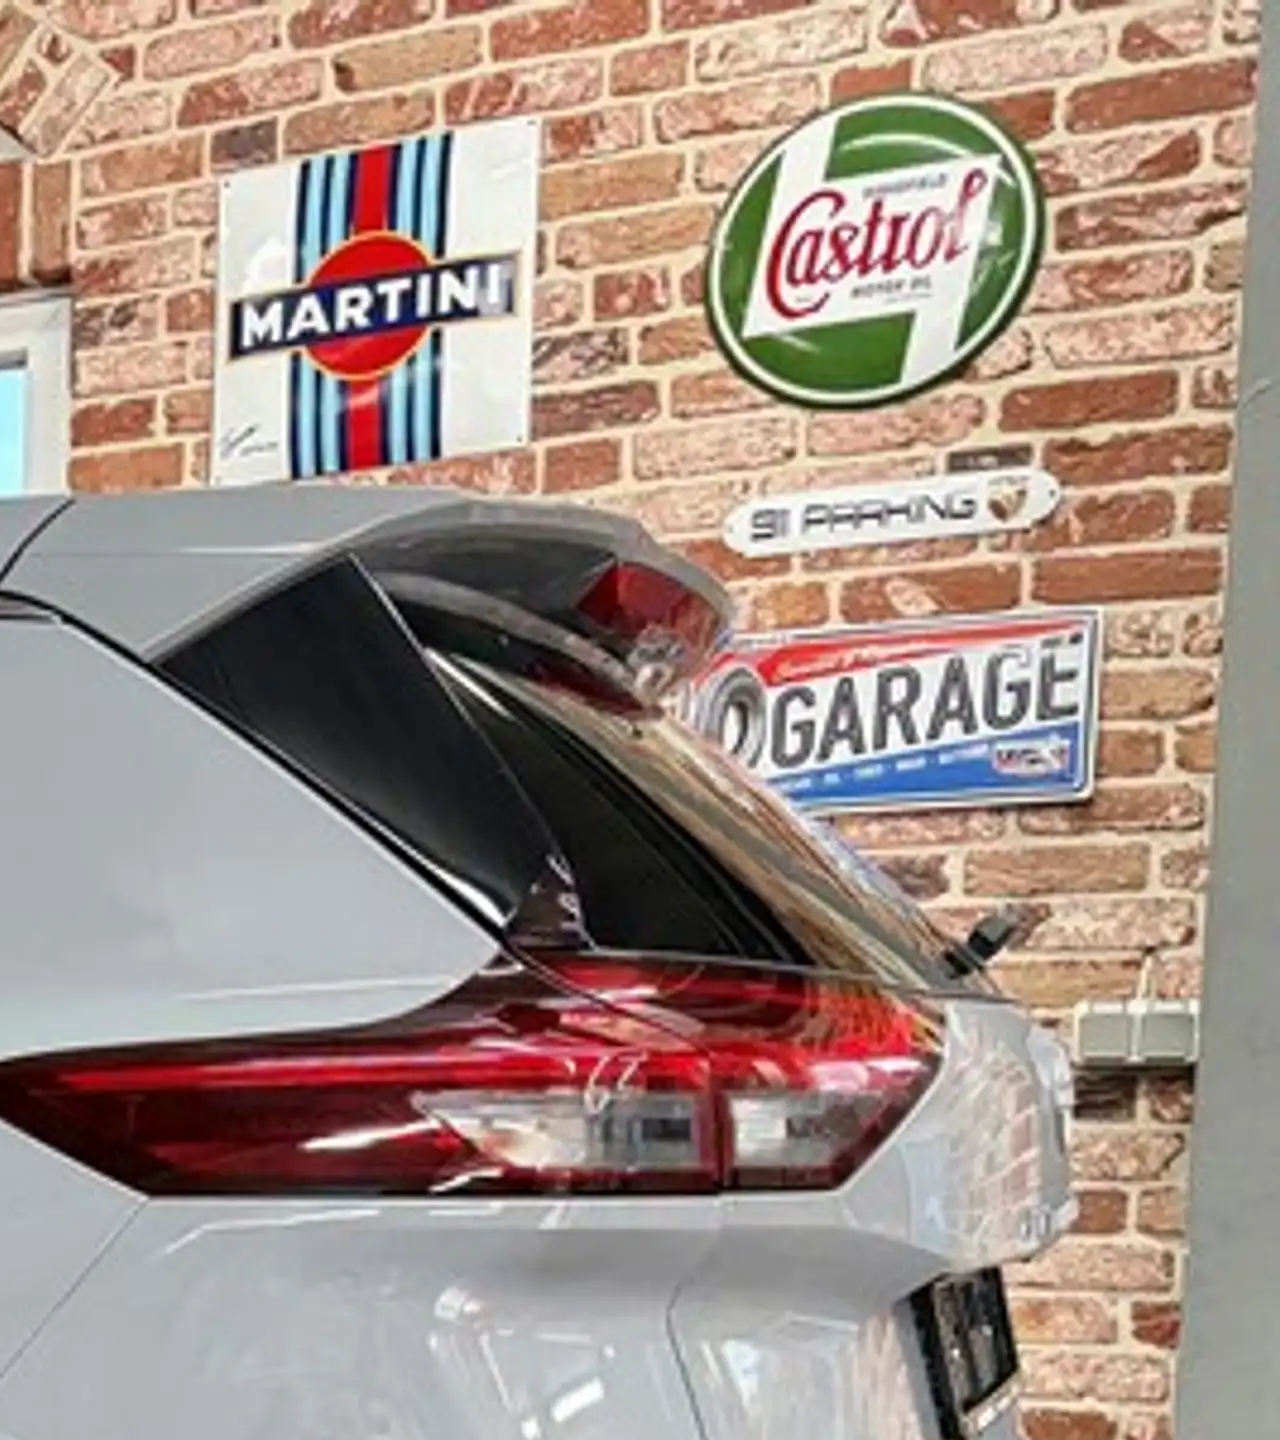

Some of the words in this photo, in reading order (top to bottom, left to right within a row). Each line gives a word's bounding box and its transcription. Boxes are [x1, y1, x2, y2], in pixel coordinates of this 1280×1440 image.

[766, 168, 989, 323] Castrol
[241, 263, 502, 349] MARTINI
[800, 492, 980, 535] PARKING
[769, 648, 1082, 770] GARAGE
